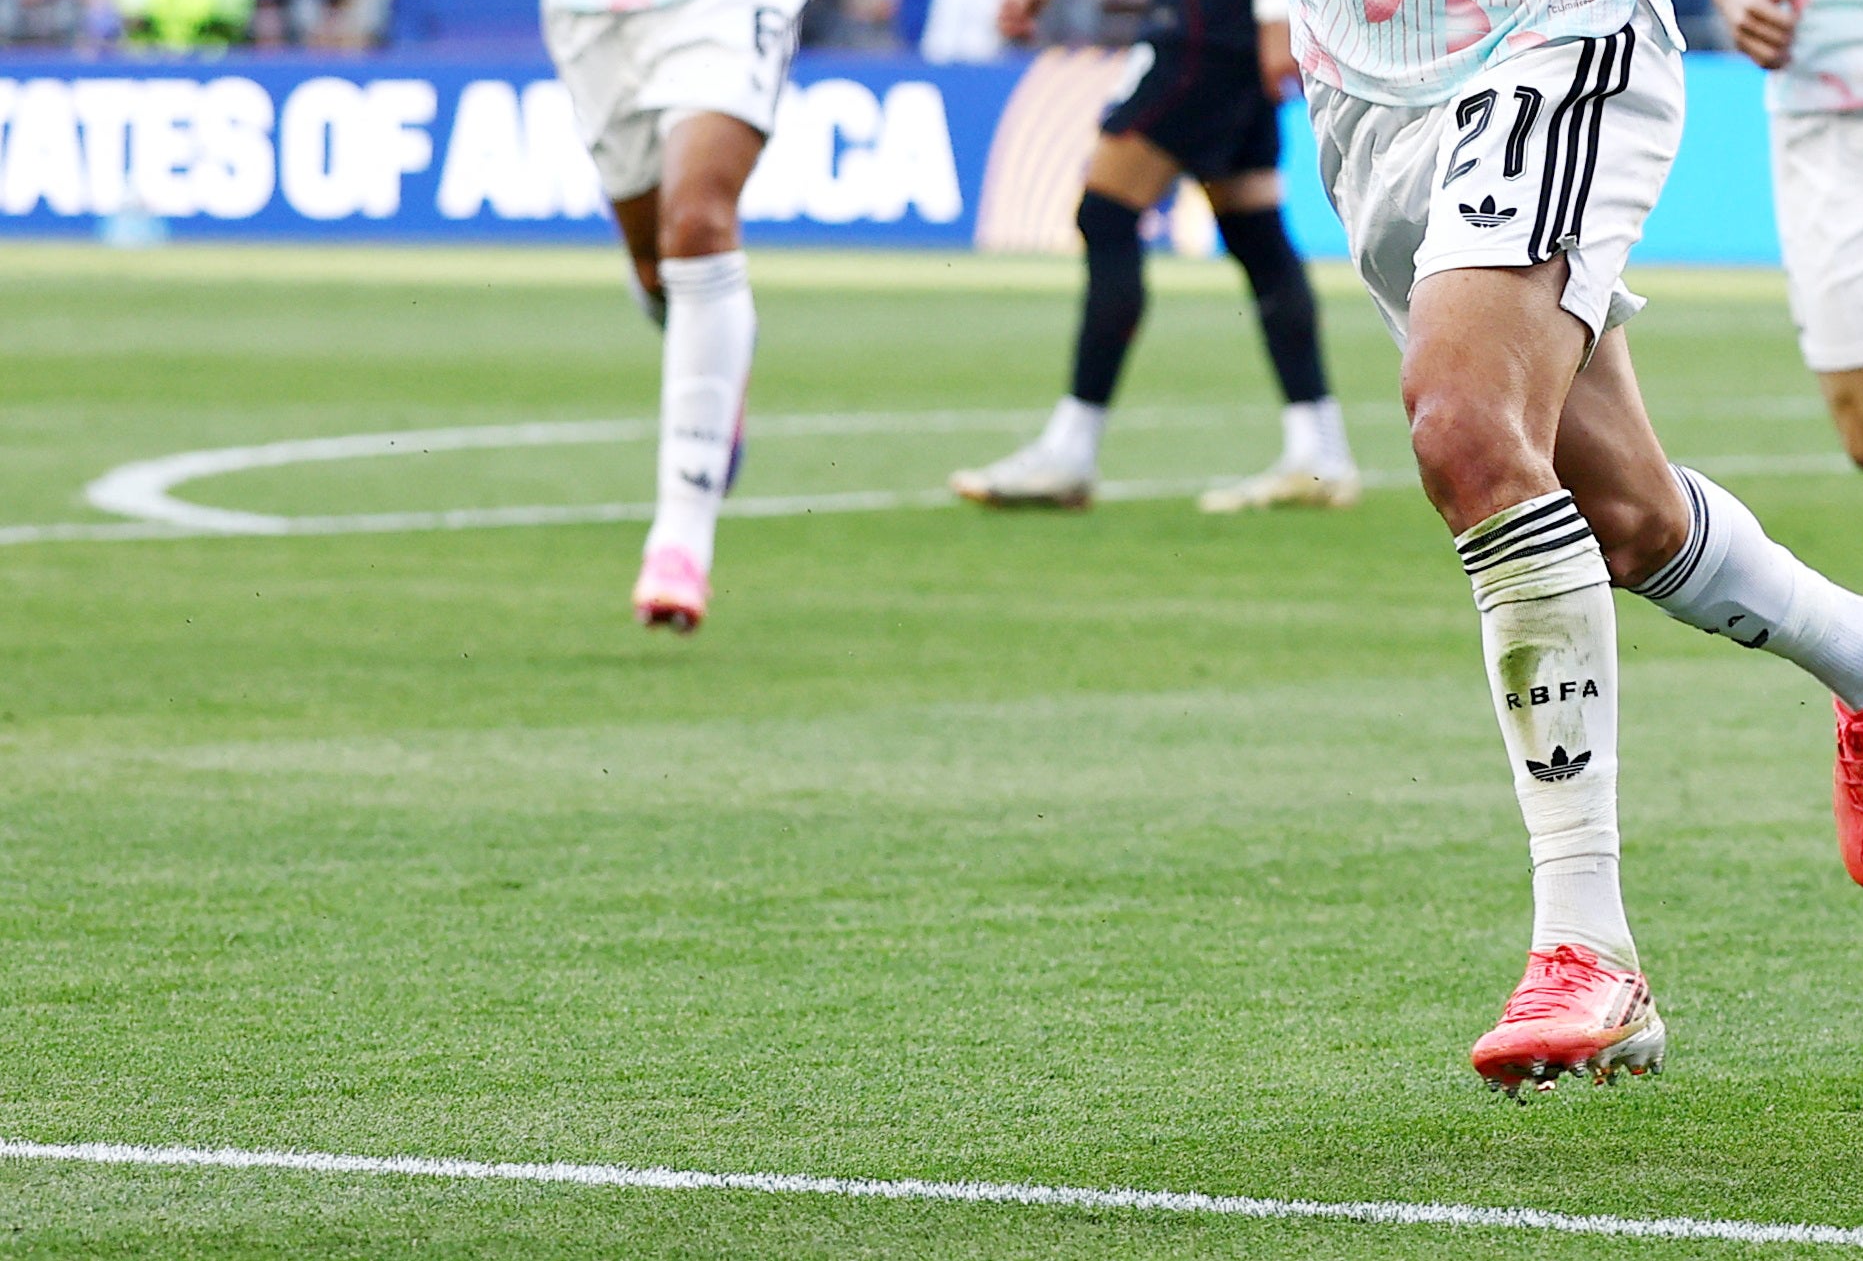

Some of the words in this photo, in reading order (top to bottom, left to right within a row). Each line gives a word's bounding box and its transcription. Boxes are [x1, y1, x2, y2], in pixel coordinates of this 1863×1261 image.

[281, 76, 438, 220] OF
[436, 77, 963, 224] AMICA
[1442, 85, 1546, 190] 21
[1505, 678, 1599, 711] RBFA
